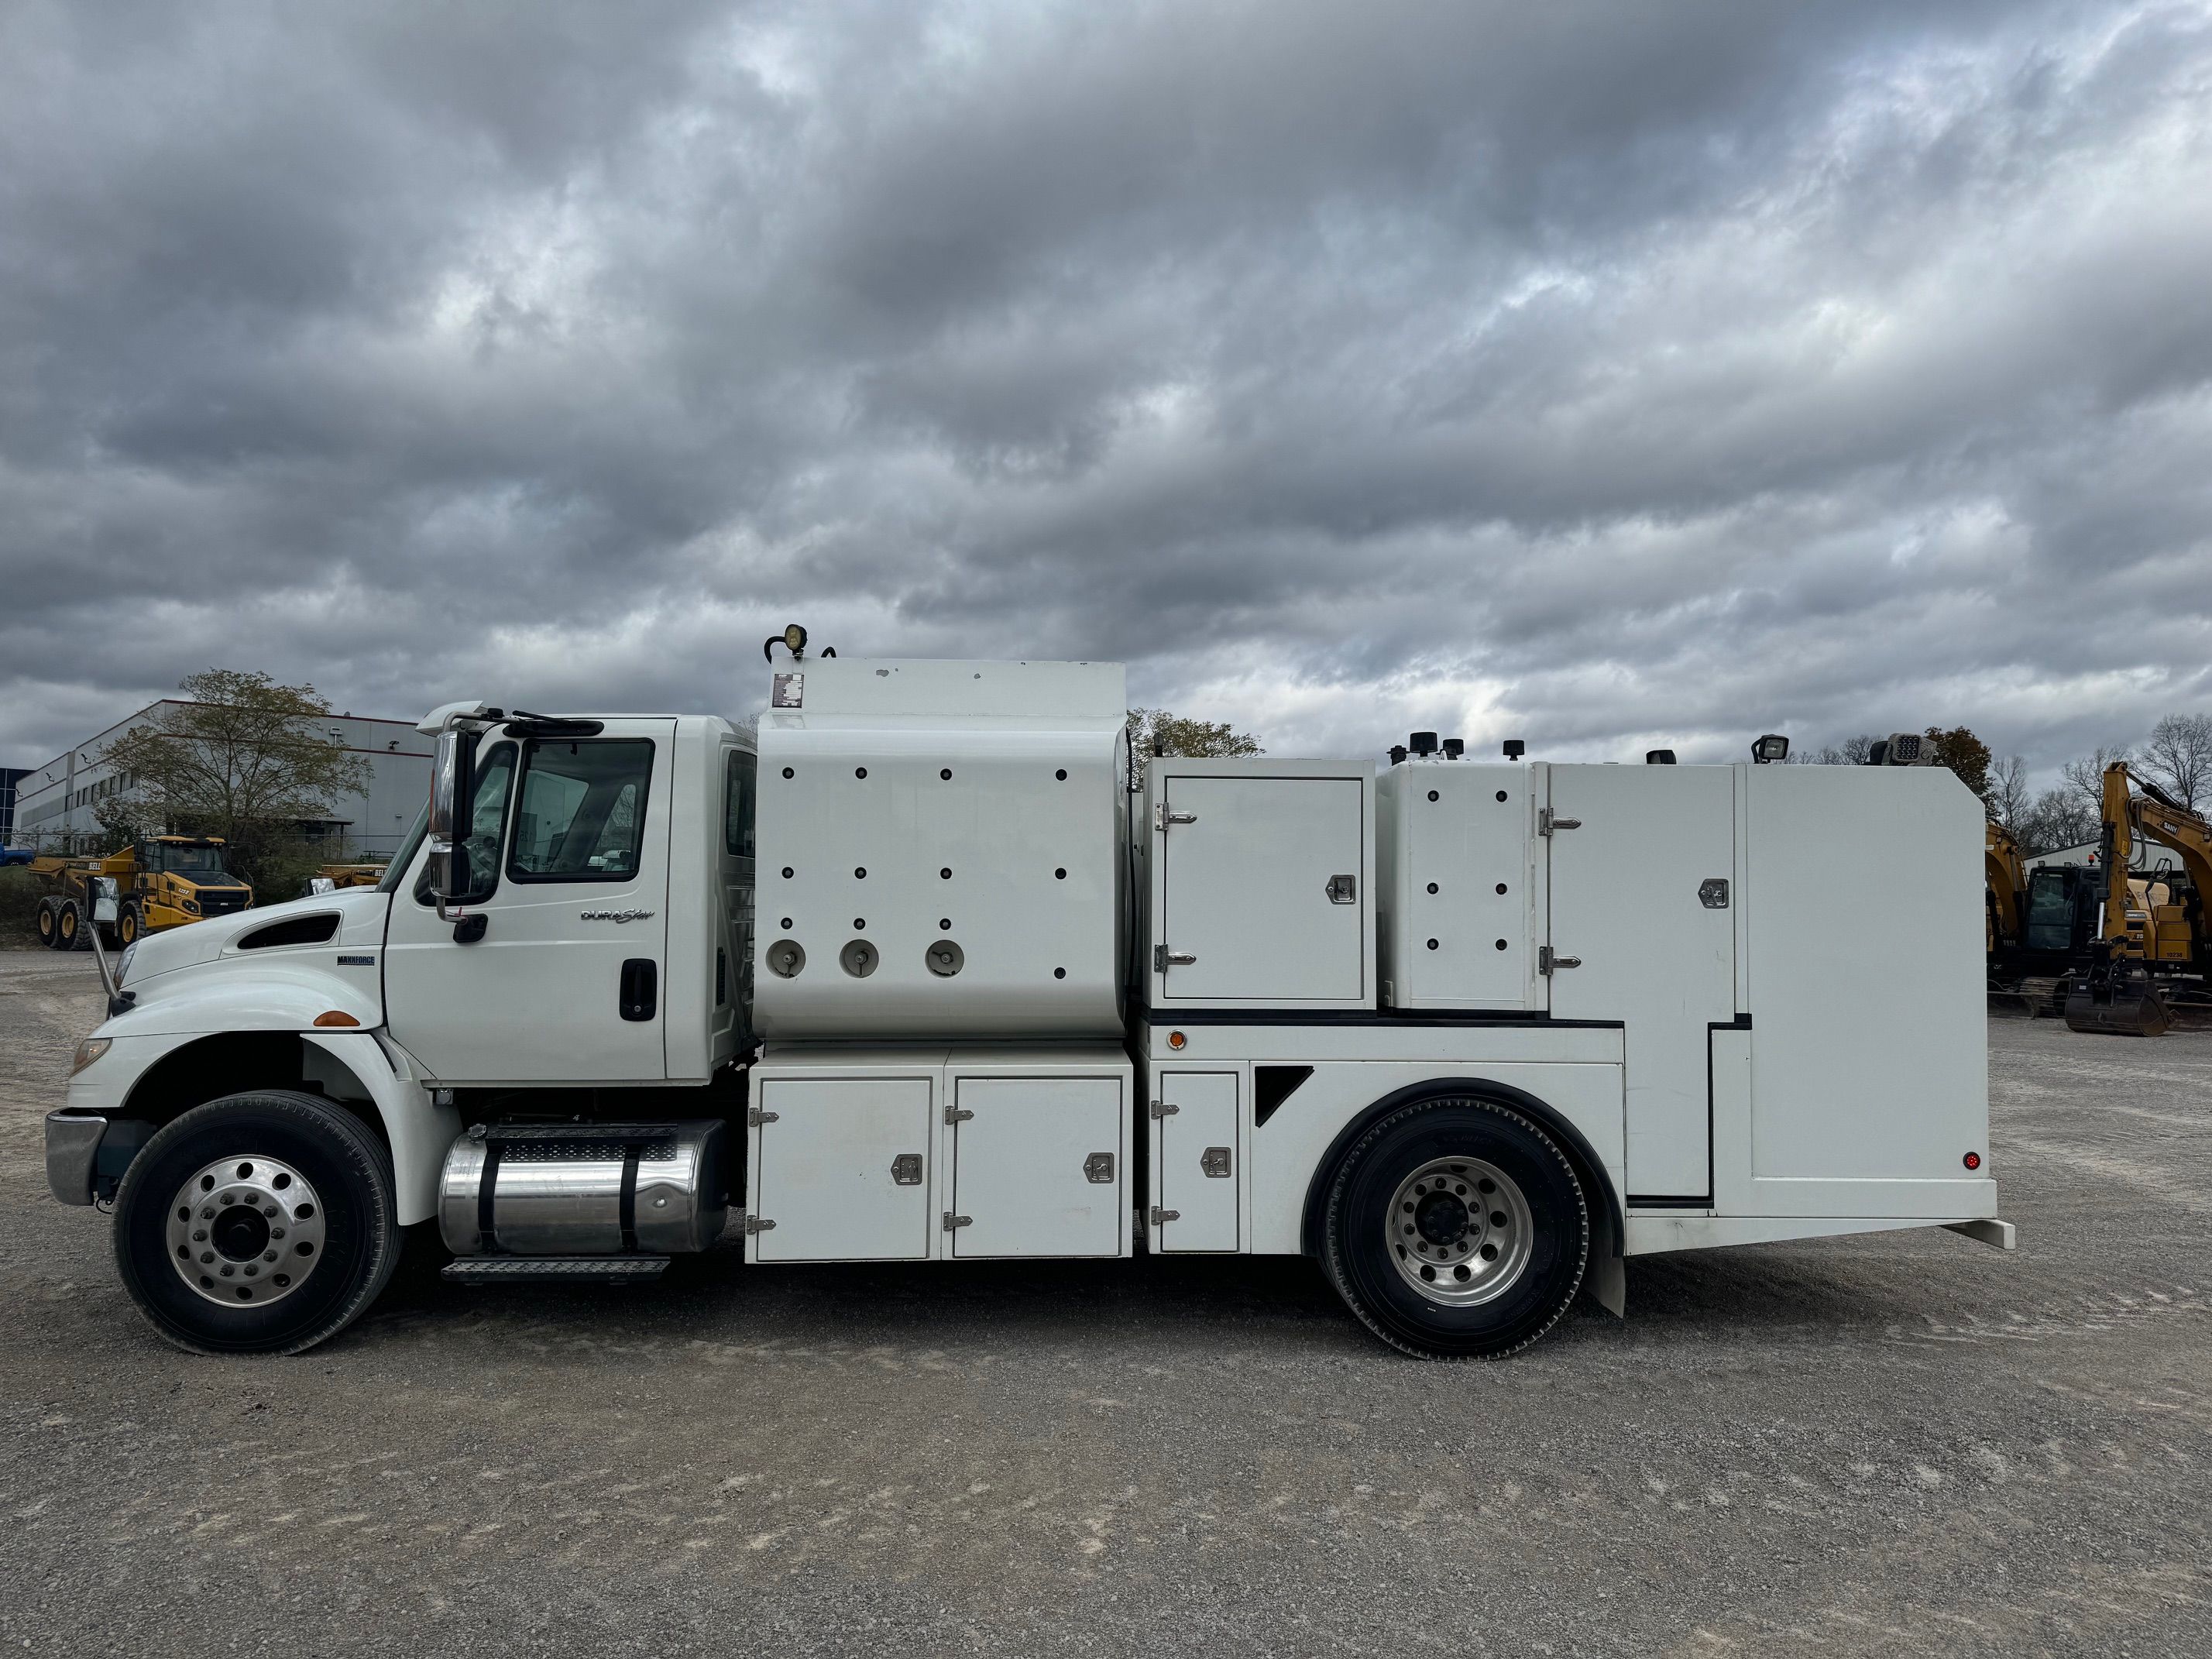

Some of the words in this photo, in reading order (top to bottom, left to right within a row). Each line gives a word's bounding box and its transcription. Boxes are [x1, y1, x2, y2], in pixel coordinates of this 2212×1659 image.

[2163, 822, 2178, 833] SANY
[88, 862, 101, 871] BELL
[337, 956, 375, 964] MAXXFORCE
